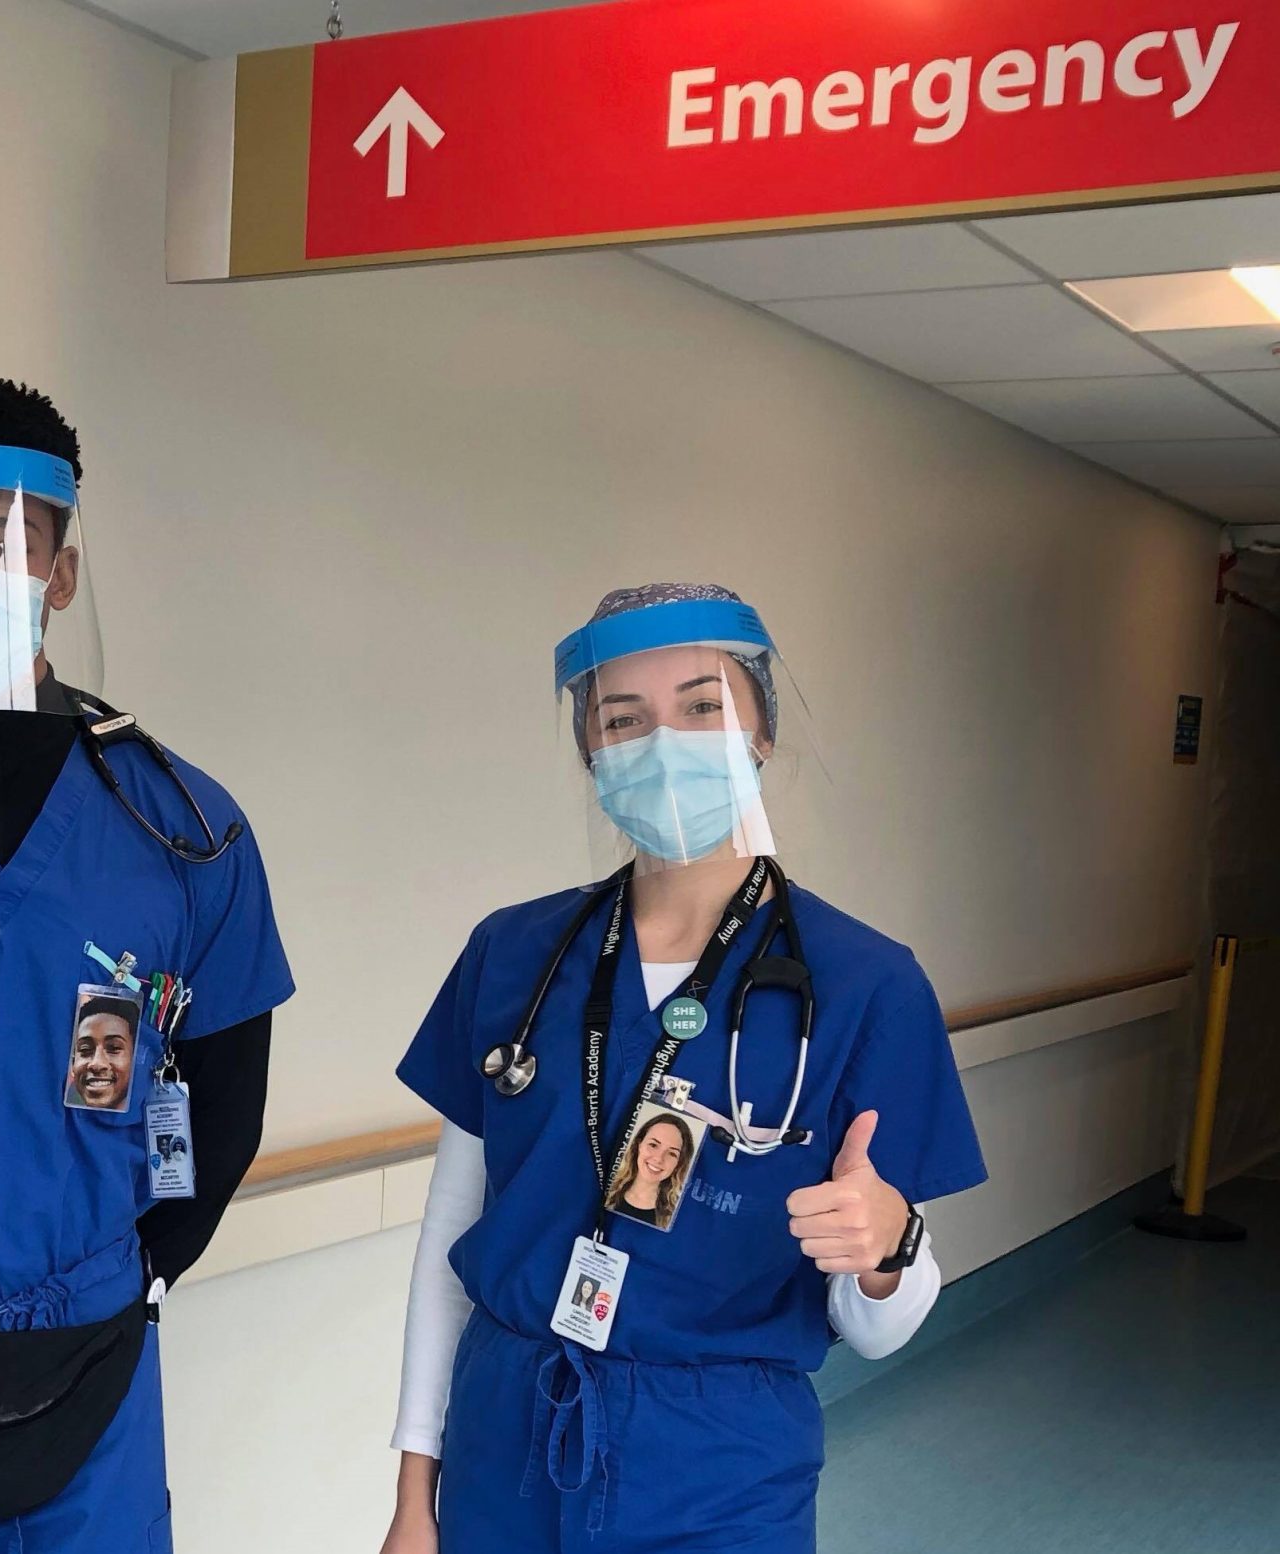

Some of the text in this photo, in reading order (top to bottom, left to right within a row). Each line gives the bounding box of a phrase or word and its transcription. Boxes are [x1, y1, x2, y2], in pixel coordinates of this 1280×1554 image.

[667, 21, 1241, 148] Emergency
[672, 1006, 697, 1016] SHE
[672, 1020, 697, 1030] HER
[586, 1030, 603, 1087] Academy
